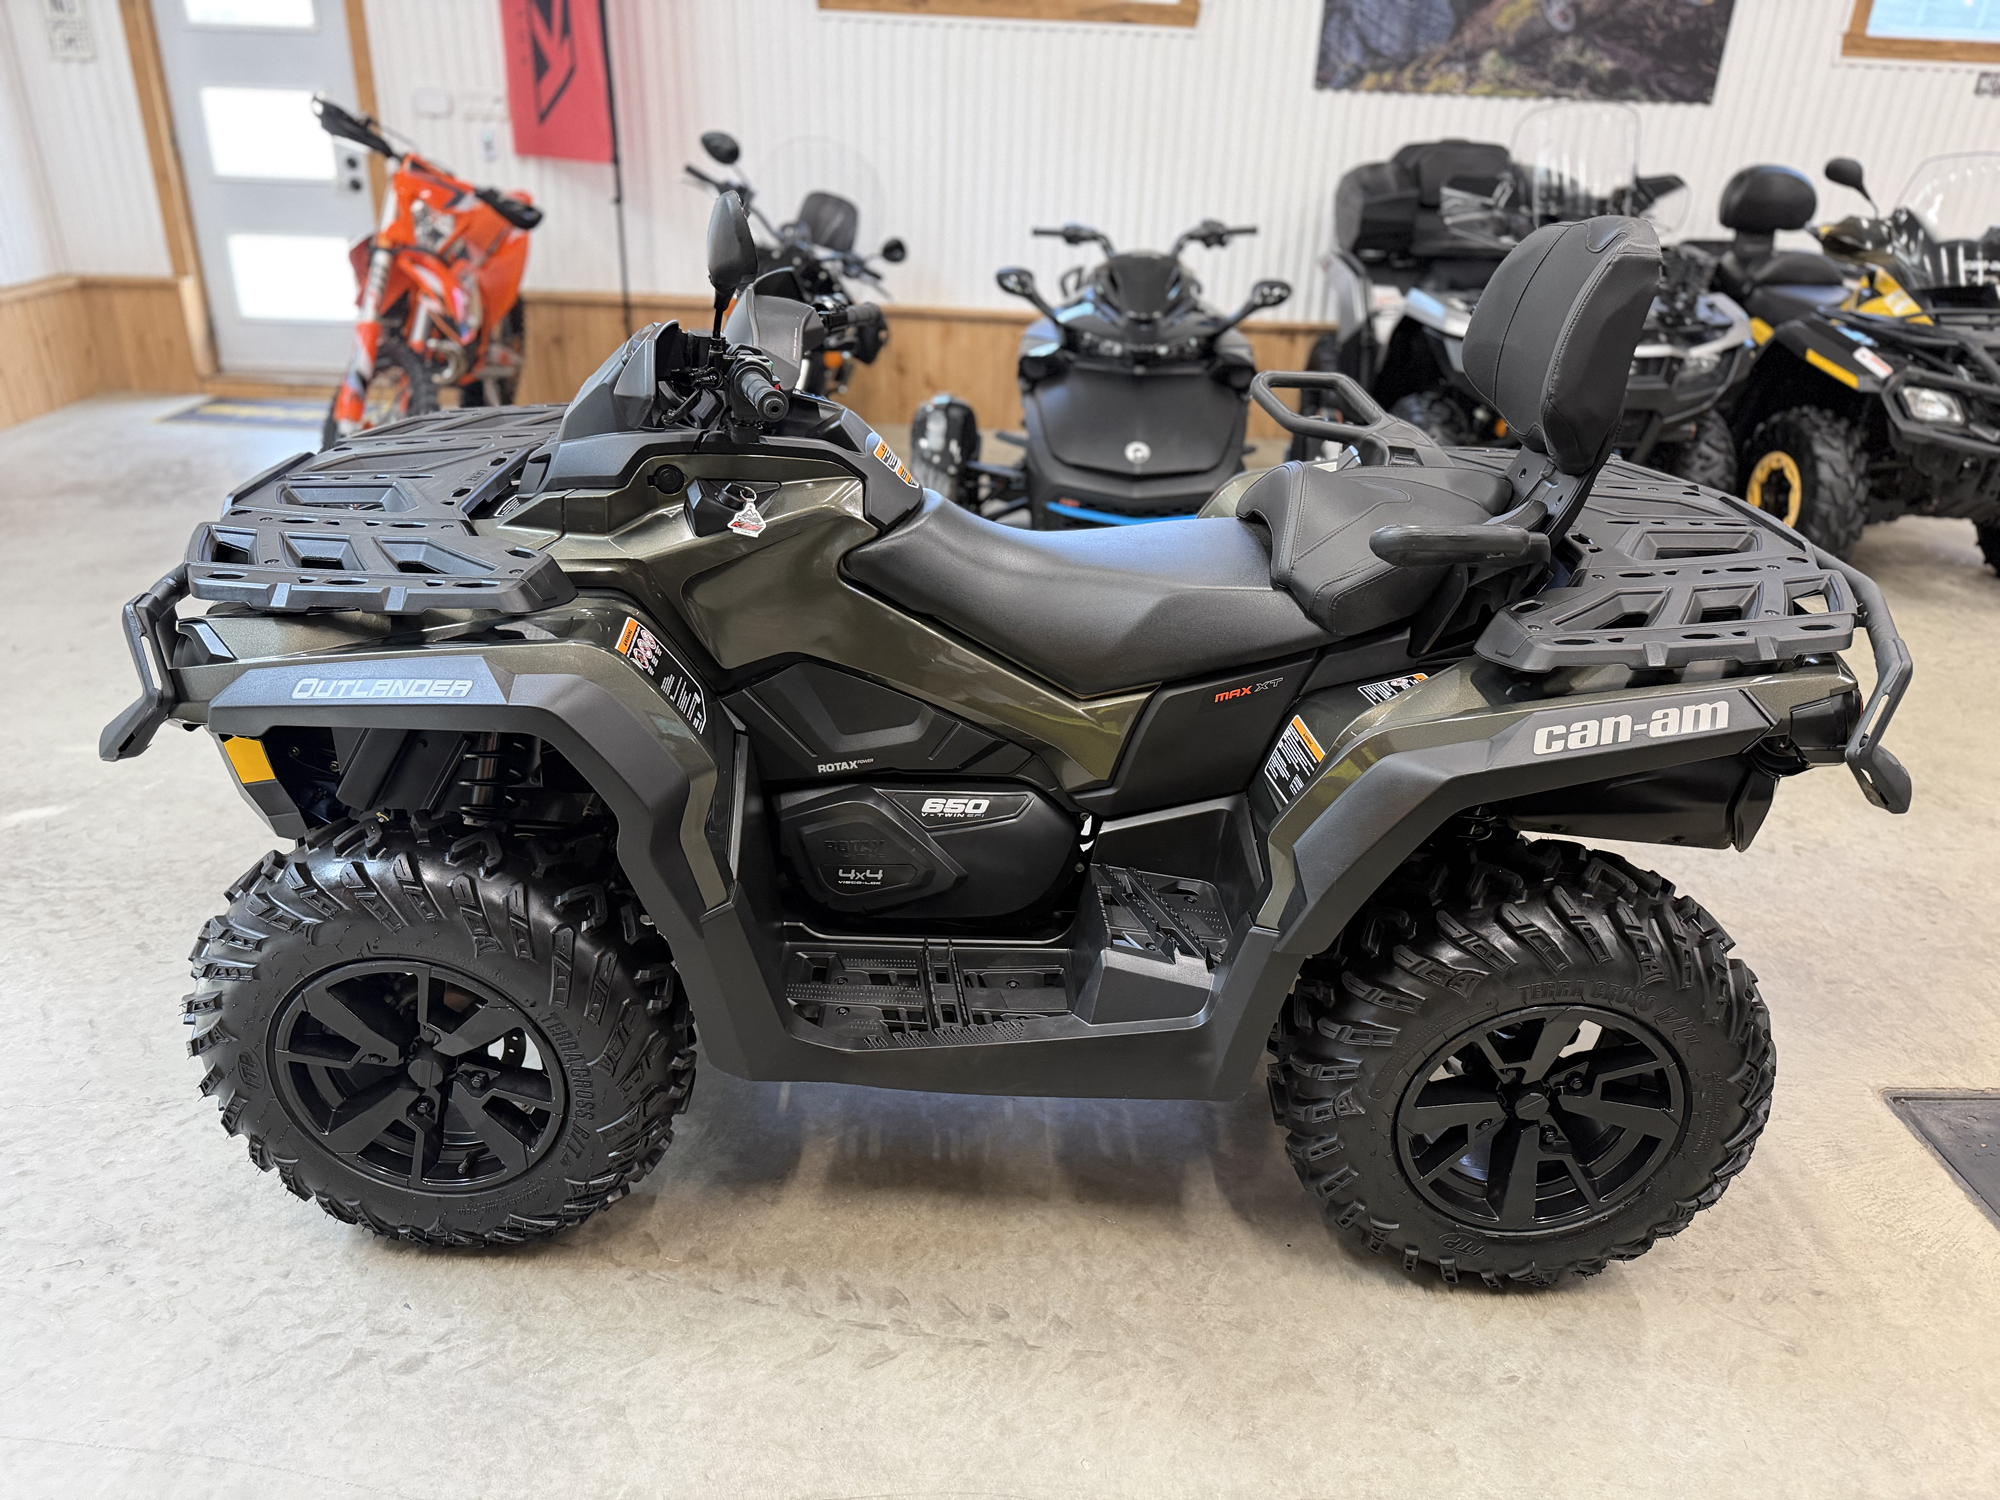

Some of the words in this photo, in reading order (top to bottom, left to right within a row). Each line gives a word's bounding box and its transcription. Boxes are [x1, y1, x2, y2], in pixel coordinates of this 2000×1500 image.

[292, 678, 474, 699] OUTLANDER
[1214, 685, 1252, 703] MAX
[1254, 677, 1284, 692] XT
[1533, 700, 1730, 755] can-am
[817, 760, 858, 773] ROTAX
[921, 798, 990, 813] 650
[838, 869, 884, 880] 4x4
[1517, 979, 1585, 1002] TERRA
[1590, 980, 1658, 1012] CROSS
[540, 1011, 585, 1064] TERRA
[570, 1066, 596, 1121] CROSS
